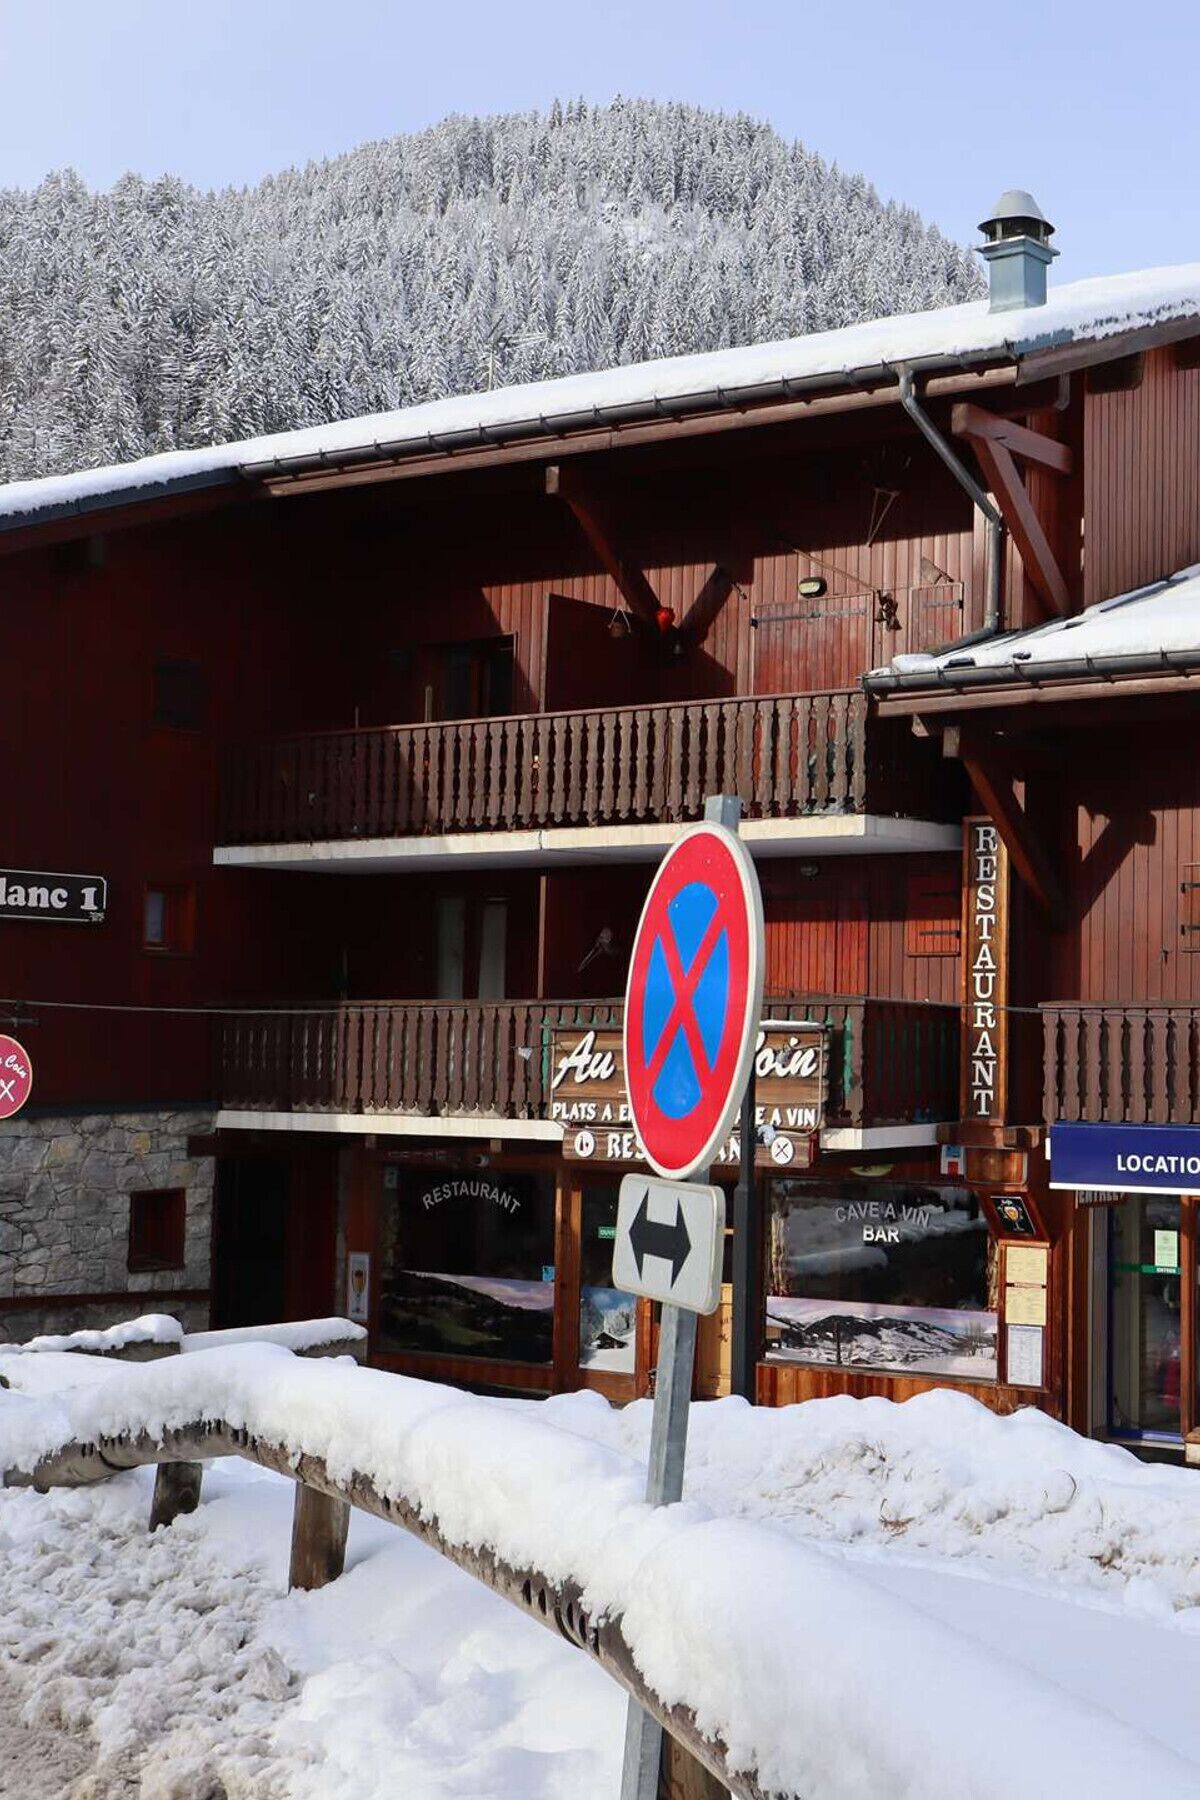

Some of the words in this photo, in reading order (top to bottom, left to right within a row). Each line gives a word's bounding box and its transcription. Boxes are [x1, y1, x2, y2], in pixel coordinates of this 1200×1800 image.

[81, 887, 98, 910] 1
[972, 826, 998, 1115] RESTAURANT
[551, 1030, 615, 1089] Au
[756, 1031, 818, 1077] oin
[552, 1102, 597, 1121] PLATS
[601, 1103, 613, 1121] A
[771, 1107, 782, 1126] A
[786, 1108, 816, 1127] VIN
[422, 1180, 521, 1215] RESTAURANT
[835, 1201, 880, 1222] CAVE
[884, 1203, 897, 1219] A
[902, 1205, 929, 1228] VIN
[862, 1224, 900, 1243] BAR
